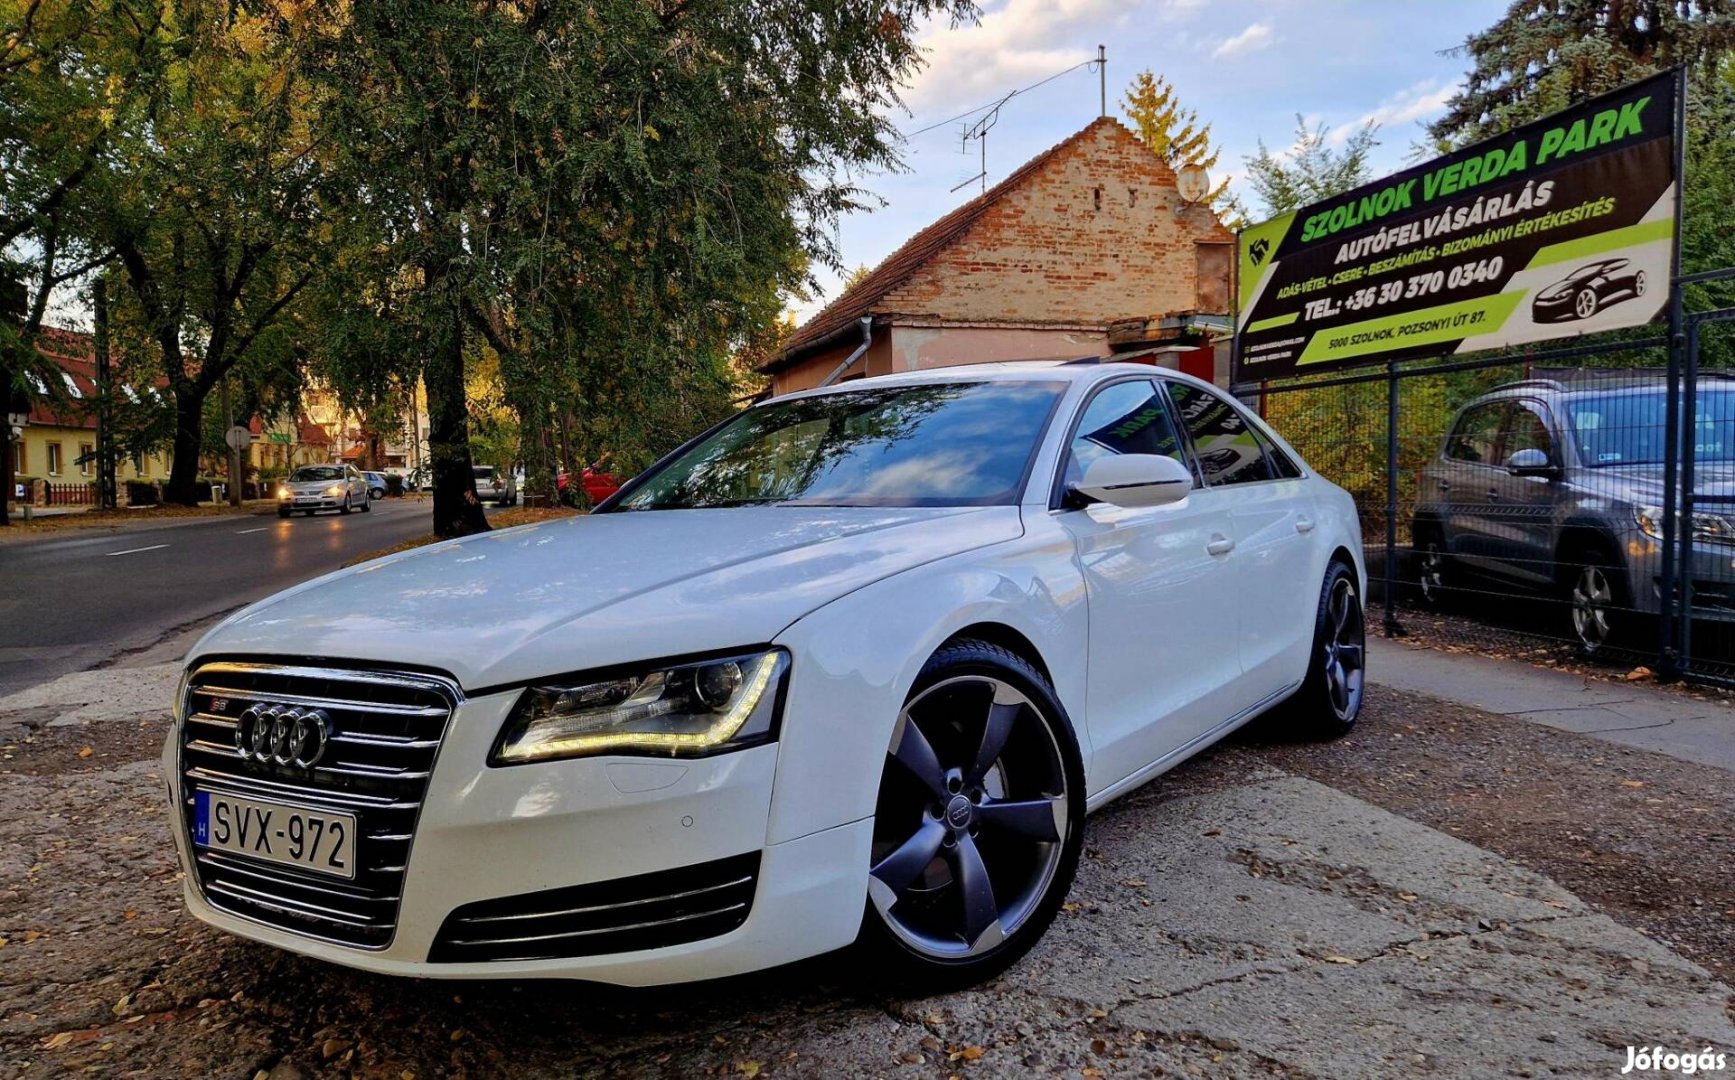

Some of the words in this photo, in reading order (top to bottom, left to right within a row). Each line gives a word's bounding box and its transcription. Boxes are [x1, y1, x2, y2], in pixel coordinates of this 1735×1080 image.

[1300, 178, 1418, 243] SZOLNOK
[1423, 139, 1529, 201] VERDA
[1536, 96, 1652, 166] PARK
[1332, 266, 1365, 286] CSERE
[1441, 228, 1513, 257] BIZOMÁNYI
[1513, 196, 1616, 239] ÉRTÉKESÍTÉS
[1333, 180, 1555, 265] AUTÓFELVÁSÁRLÁS
[1304, 297, 1342, 321] TEL.:
[1344, 286, 1378, 311] +36
[1377, 280, 1404, 305] 30
[1404, 270, 1445, 299] 370
[1447, 256, 1504, 290] 0340
[1328, 336, 1349, 349] 5000
[1397, 317, 1451, 338] POZSONYI
[1453, 313, 1471, 328] ÚT
[1469, 310, 1487, 325] 87.
[198, 822, 206, 838] H
[214, 800, 345, 869] SVX-972
